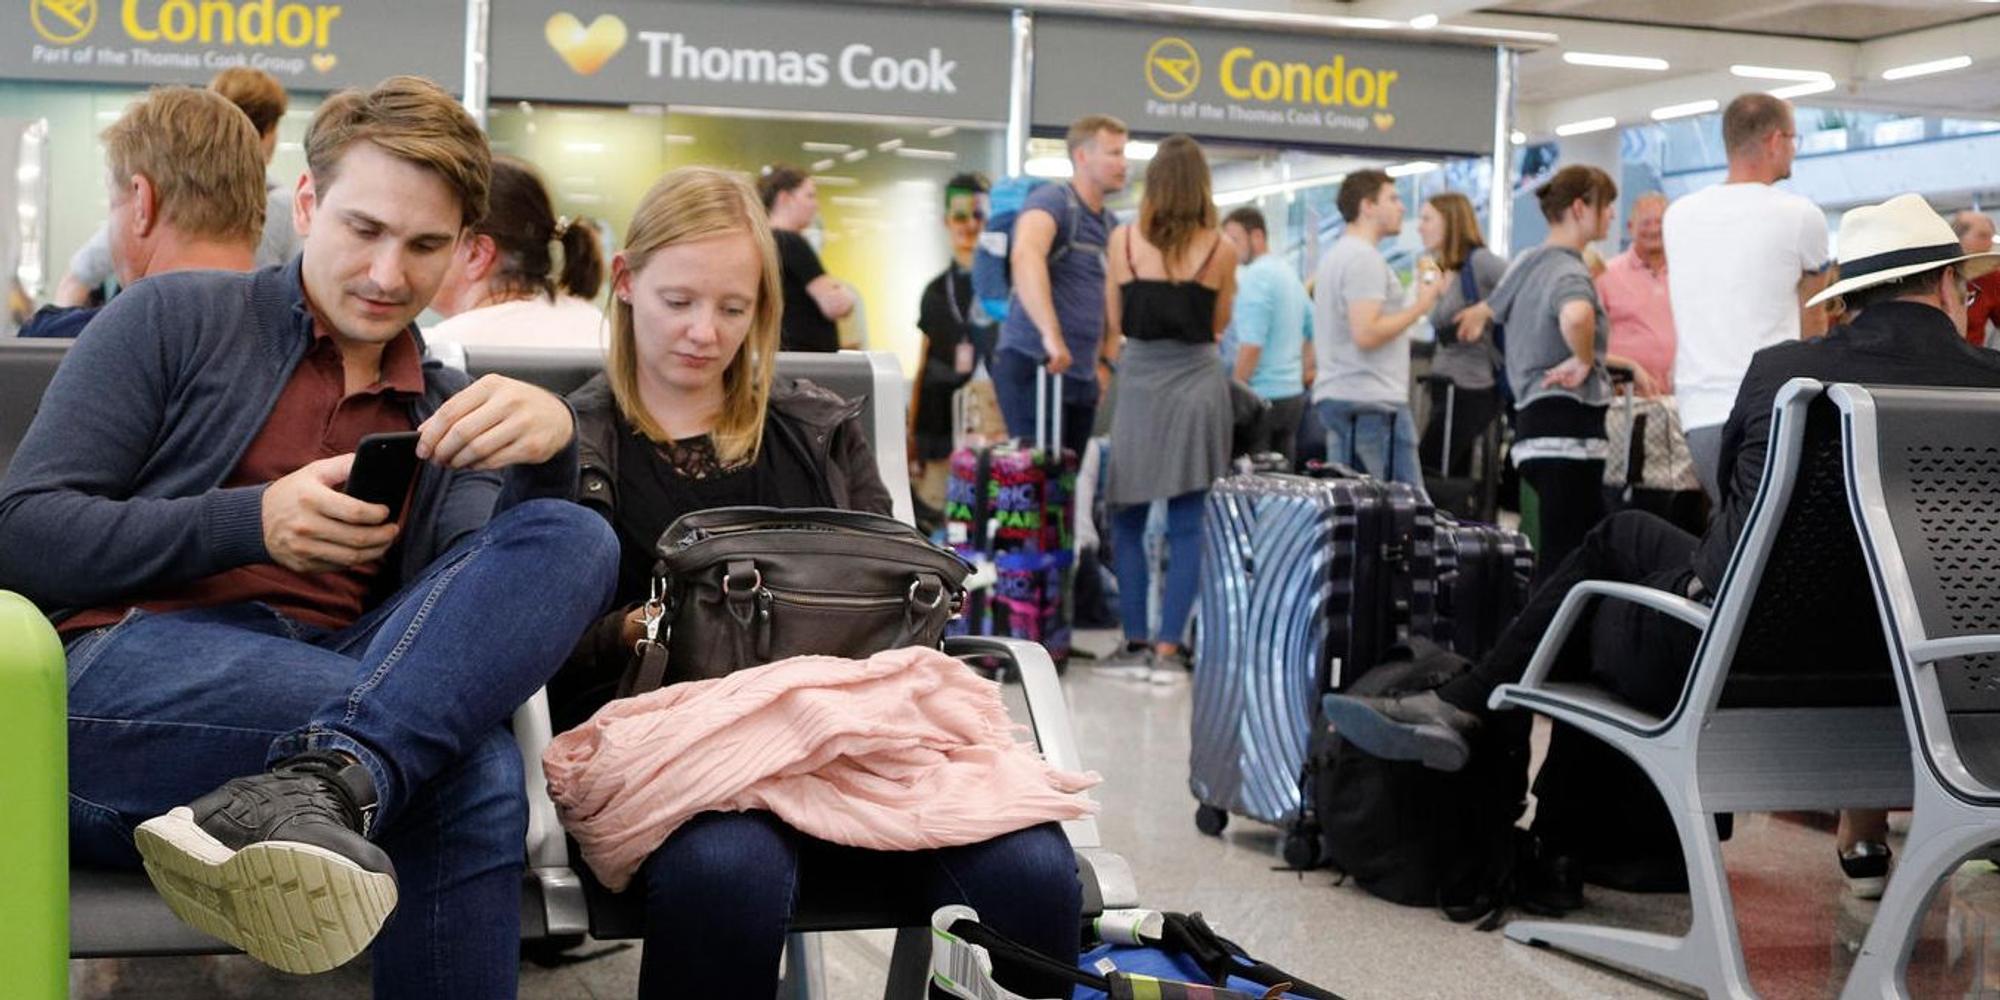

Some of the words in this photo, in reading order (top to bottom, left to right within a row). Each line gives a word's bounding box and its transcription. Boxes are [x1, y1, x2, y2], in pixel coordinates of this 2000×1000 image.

[121, 0, 342, 48] Condor
[32, 45, 69, 63] Part
[73, 46, 92, 64] of
[98, 46, 126, 65] the
[131, 48, 199, 68] Thomas
[204, 51, 247, 69] Cook
[251, 53, 305, 74] Group
[638, 31, 828, 86] Thomas
[838, 44, 957, 93] Cook
[1219, 47, 1397, 108] Condor
[1146, 99, 1177, 116] Part
[1180, 101, 1197, 118] of
[1200, 102, 1225, 119] the
[1228, 105, 1284, 124] Thomas
[1287, 108, 1322, 126] Cook
[1325, 111, 1369, 132] Group
